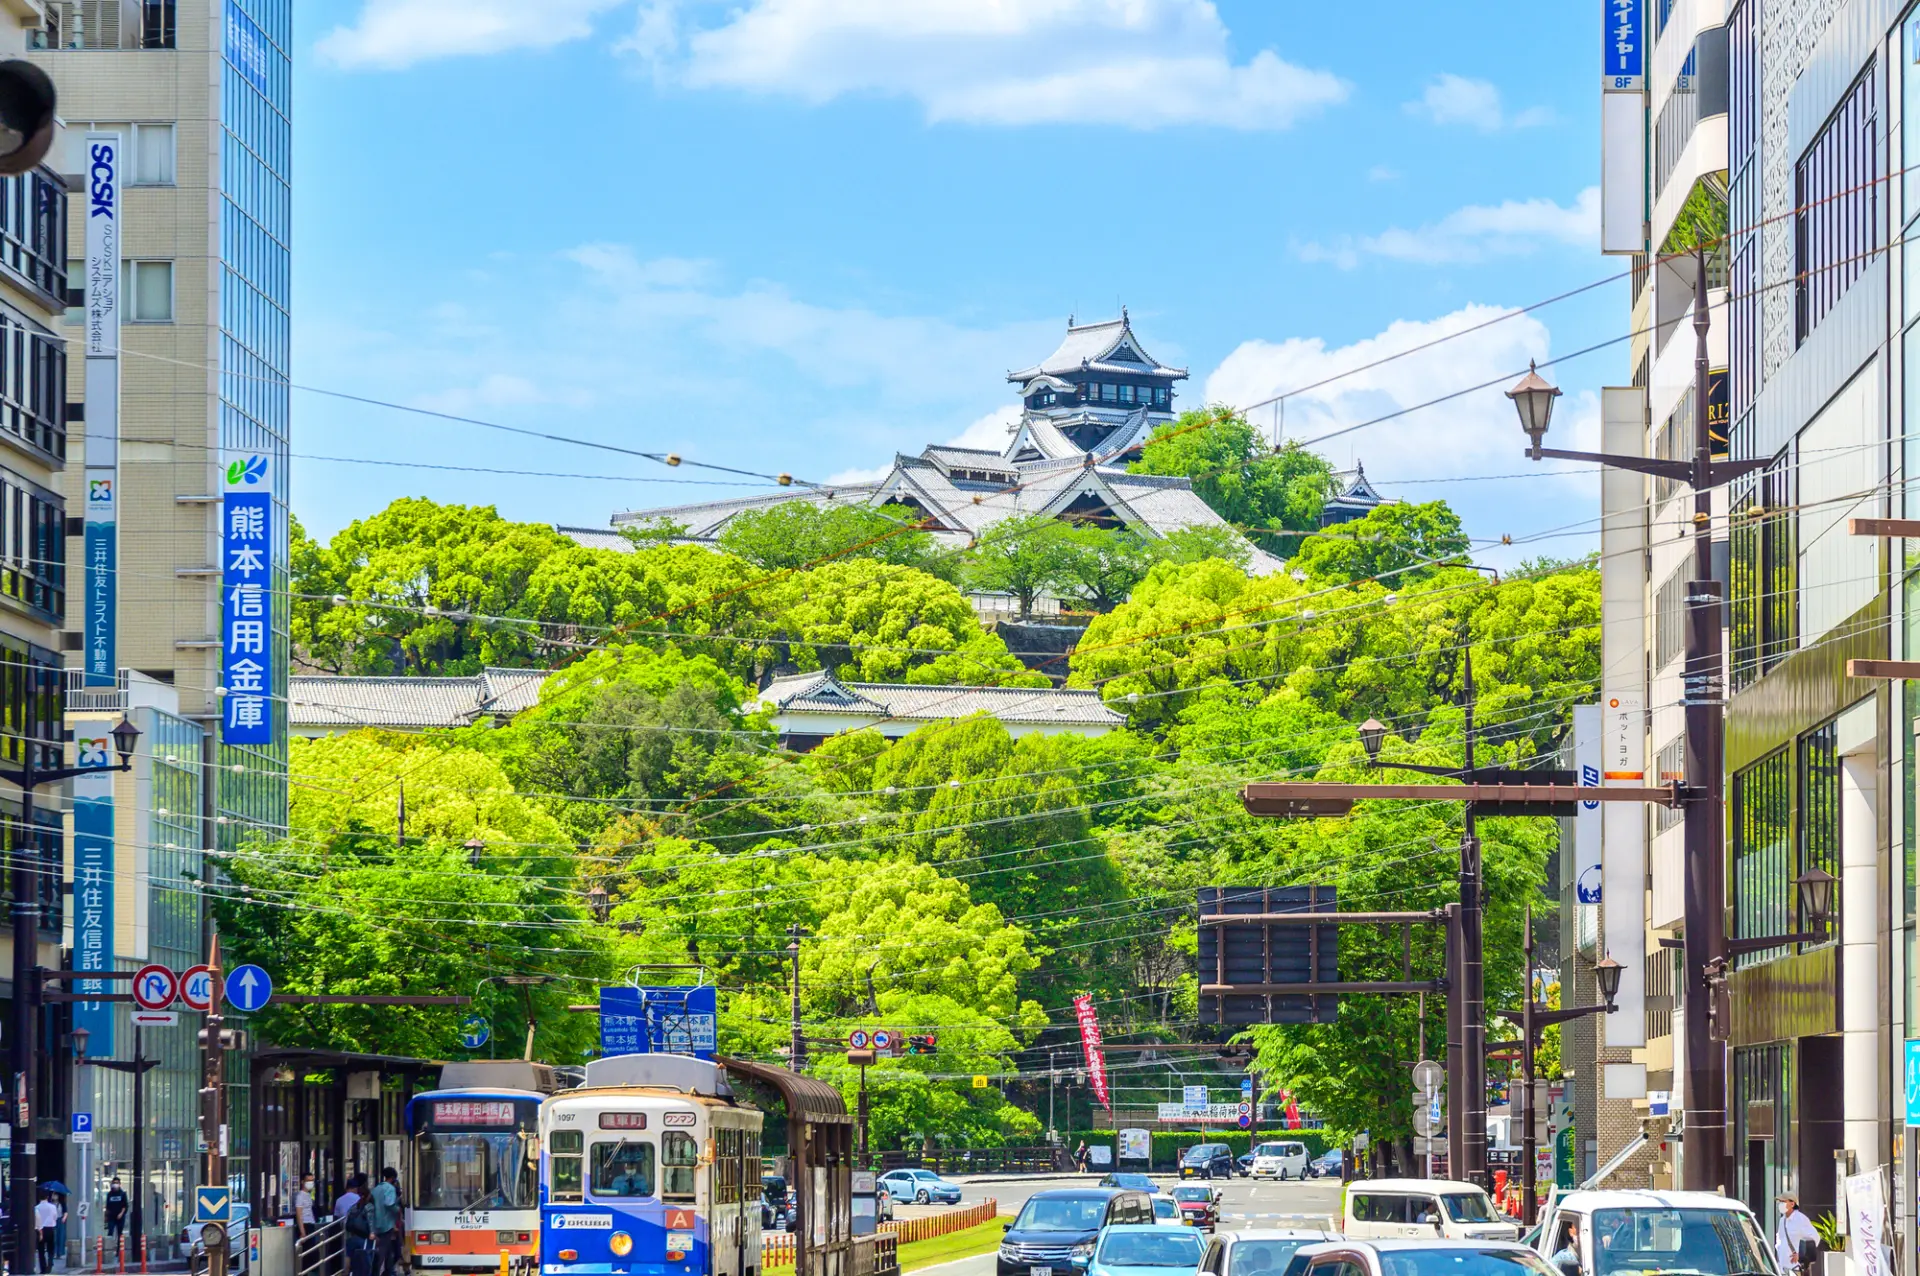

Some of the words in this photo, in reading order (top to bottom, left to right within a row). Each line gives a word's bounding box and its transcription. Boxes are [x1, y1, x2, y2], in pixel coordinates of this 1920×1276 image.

[1614, 76, 1632, 88] 8F
[91, 143, 114, 220] SCSK
[103, 224, 113, 317] SCSKニアショア
[92, 256, 102, 352] システムズ株式会社
[93, 538, 108, 674] 三井住友トラスト不動産
[229, 505, 265, 729] 熊本信用金庫
[1618, 712, 1628, 767] ホットヨガ
[82, 847, 103, 1012] 三井住友信託銀行
[189, 977, 211, 998] 40
[604, 1016, 638, 1026] 熊本駅
[604, 1035, 638, 1046] 熊本城
[501, 1104, 511, 1118] A
[558, 1113, 576, 1122] 1097
[665, 1114, 695, 1124] ワンマン
[77, 1114, 89, 1131] P
[79, 1203, 87, 1215] 2
[672, 1211, 688, 1228] A
[426, 1255, 445, 1264] 9205
